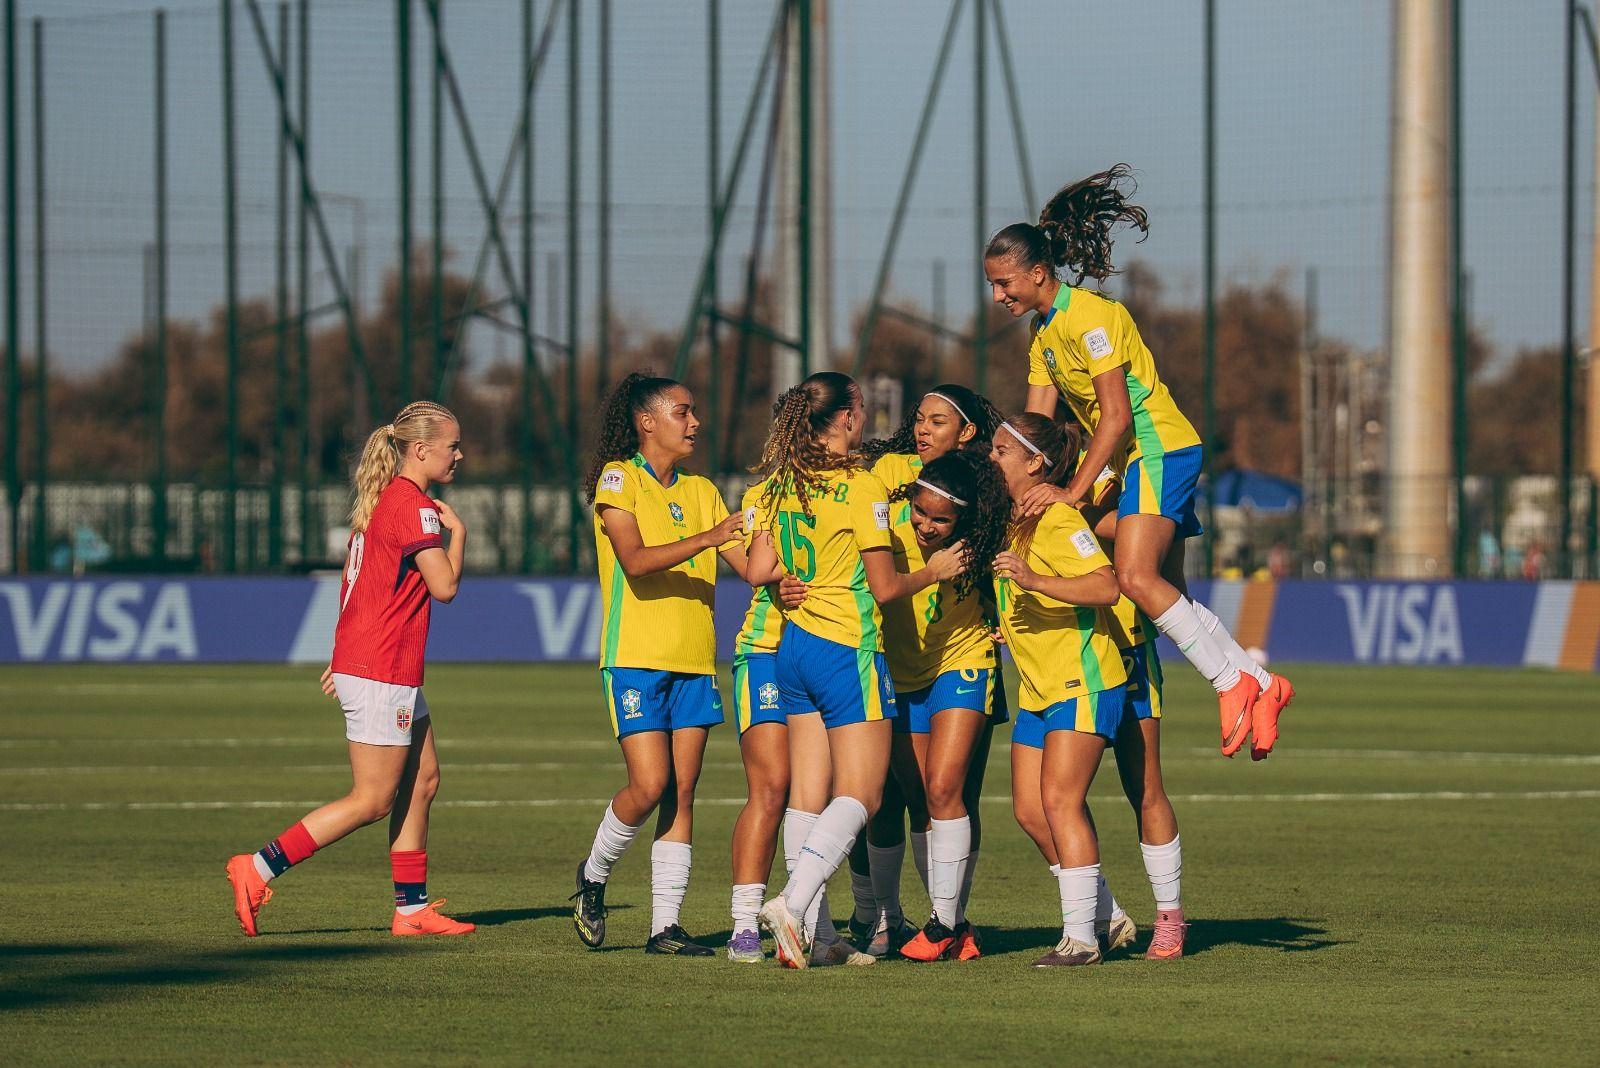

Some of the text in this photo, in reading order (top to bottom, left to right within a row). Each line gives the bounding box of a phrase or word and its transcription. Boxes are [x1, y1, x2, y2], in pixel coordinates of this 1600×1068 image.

[341, 531, 365, 613] 9
[779, 510, 816, 582] 15
[0, 582, 197, 661] VISA
[925, 591, 943, 624] 8
[1335, 584, 1464, 661] VISA
[624, 712, 643, 720] BRASIL
